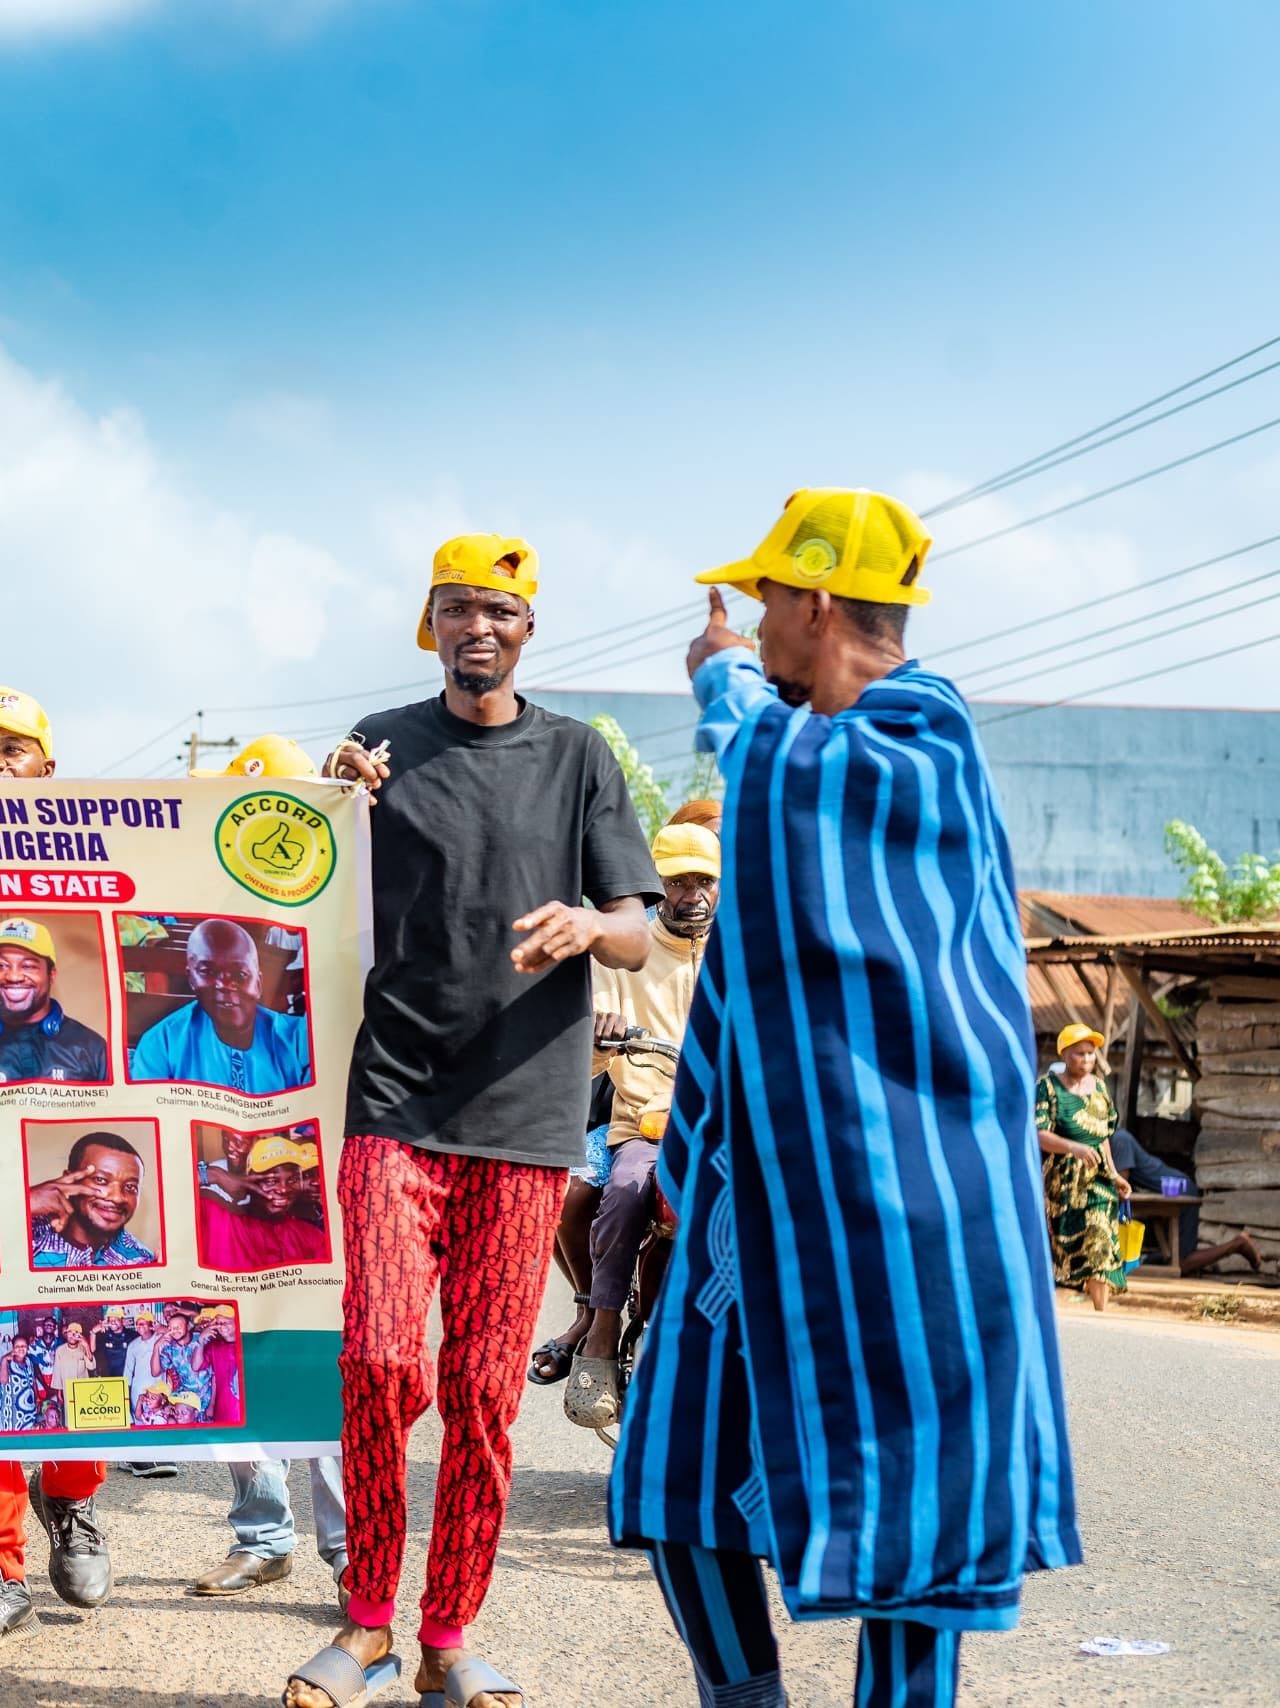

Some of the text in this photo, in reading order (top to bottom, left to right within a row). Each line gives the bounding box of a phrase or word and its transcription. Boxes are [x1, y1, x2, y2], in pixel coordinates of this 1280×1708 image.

[35, 798, 183, 829] SUPPORT
[230, 798, 323, 828] ACCORD
[29, 874, 120, 897] STATE
[49, 1087, 109, 1098] (ALATUNSE)
[170, 1087, 274, 1109] HON. DELE ONIGBINDE
[18, 1097, 28, 1107] of
[29, 1098, 97, 1109] Representative
[156, 1095, 199, 1107] Chairman
[241, 1106, 290, 1120] Secretariat
[55, 1271, 143, 1283] AFOLABI KAYODE
[215, 1268, 302, 1284] MR. FEMI GBENJO
[38, 1281, 161, 1294] Chairman Mdk Deaf Association
[191, 1277, 344, 1294] General Secretary Mdk Deaf Association
[80, 1406, 121, 1415] ACCORD
